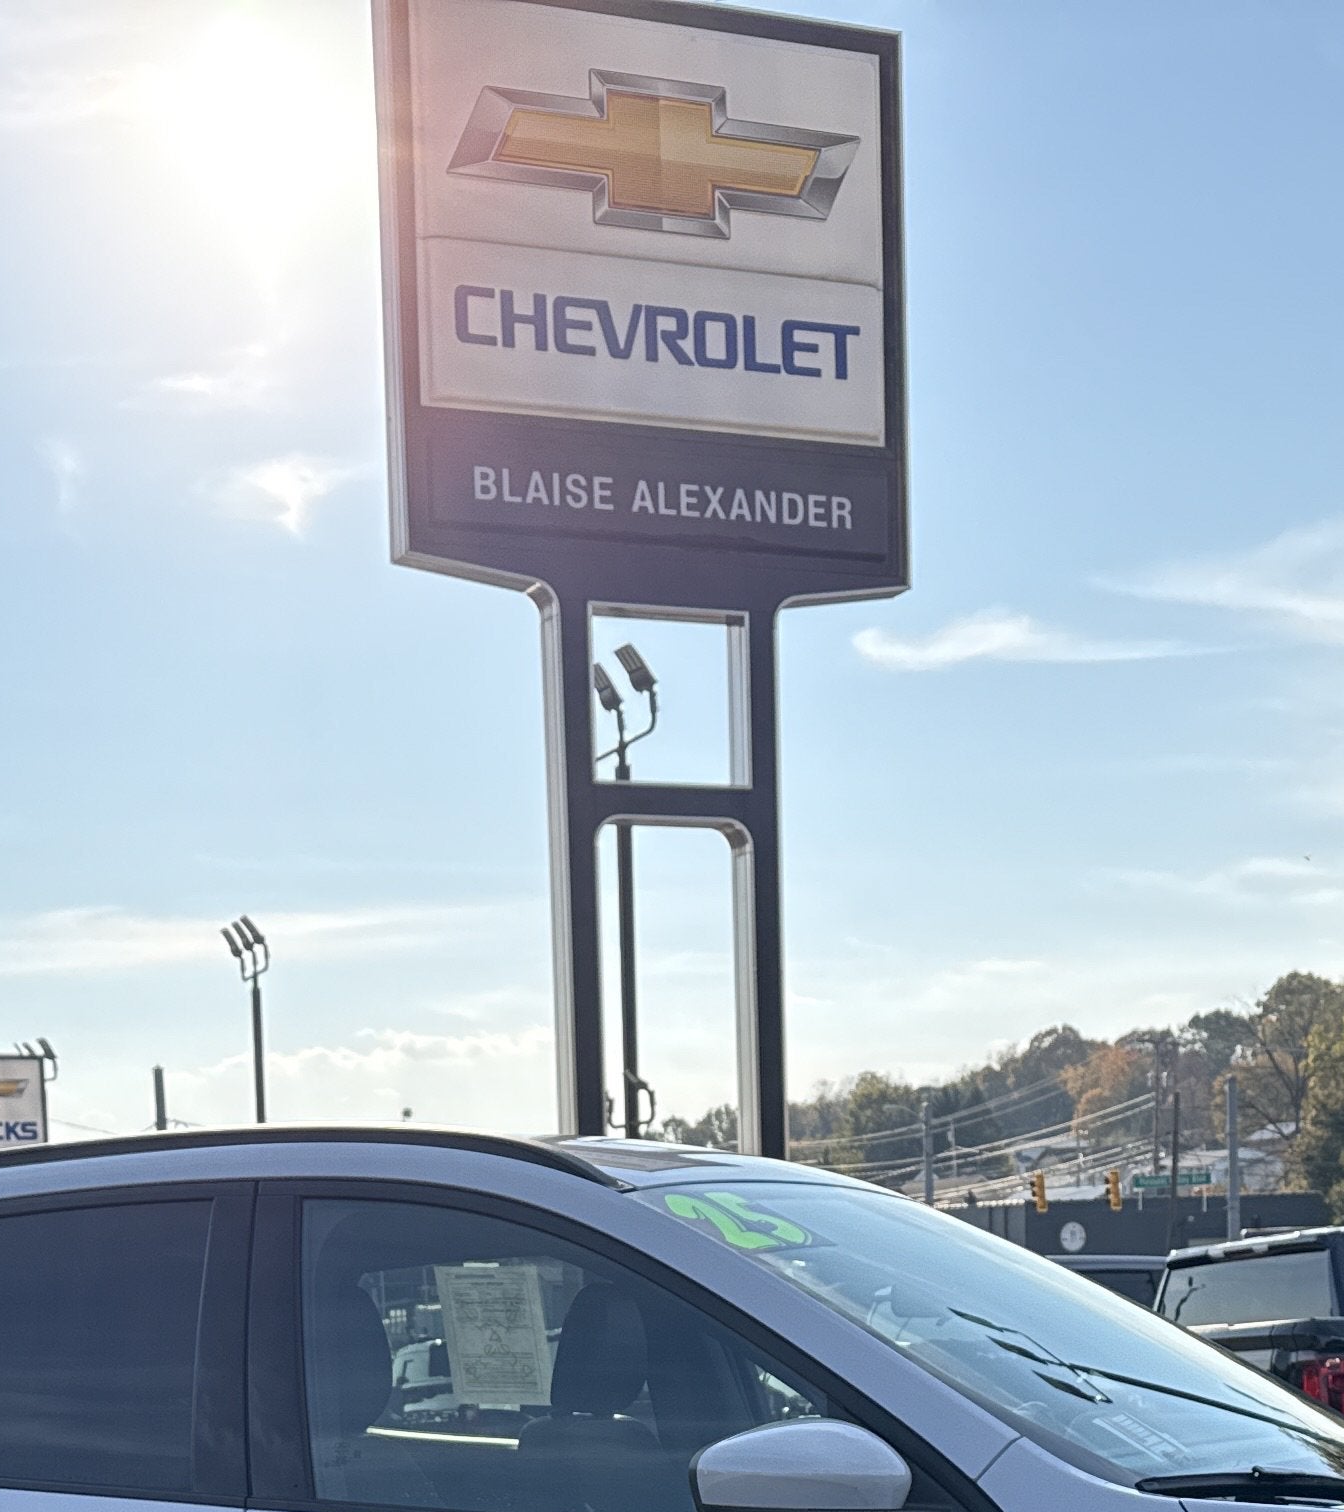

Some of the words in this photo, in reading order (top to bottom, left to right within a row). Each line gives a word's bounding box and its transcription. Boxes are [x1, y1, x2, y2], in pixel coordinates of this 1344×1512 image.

[455, 284, 861, 380] CHEVROLET
[473, 466, 614, 511] BLAISE
[632, 479, 854, 530] ALEXANDER
[664, 1191, 810, 1250] 25
